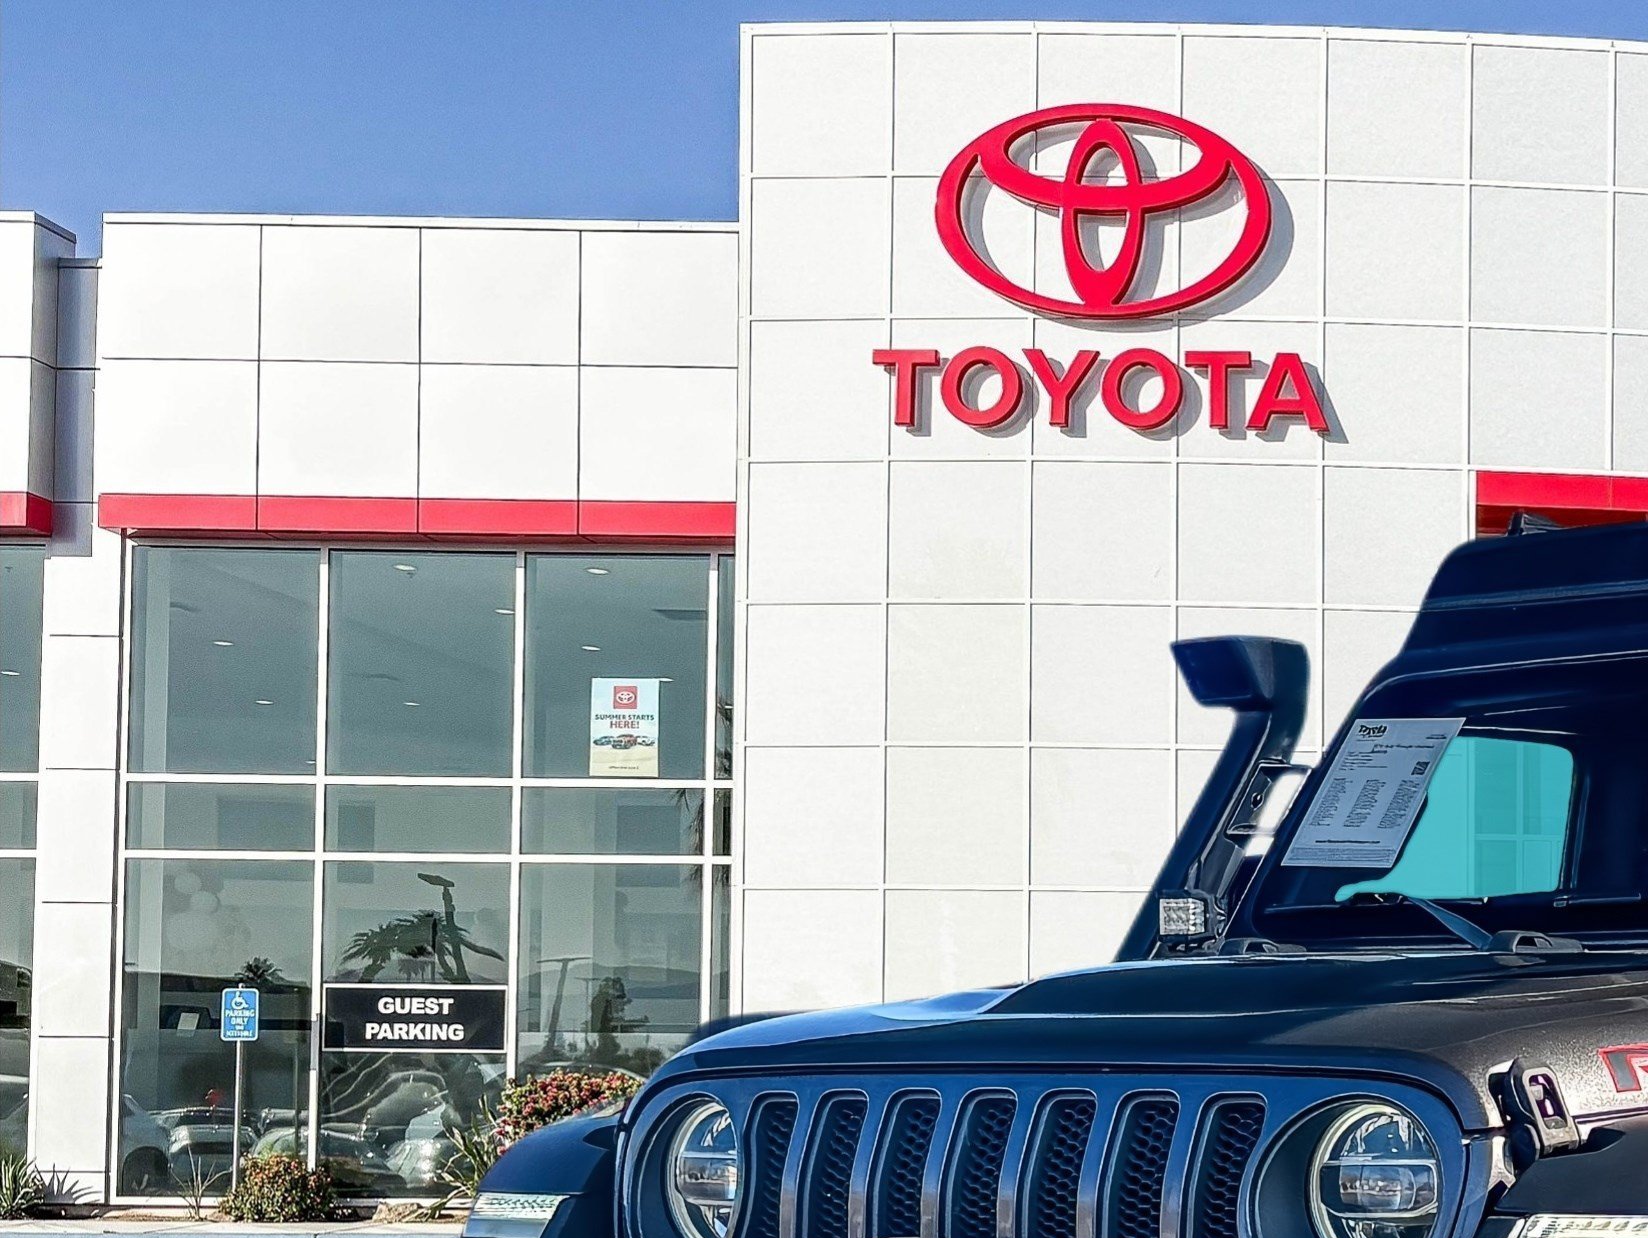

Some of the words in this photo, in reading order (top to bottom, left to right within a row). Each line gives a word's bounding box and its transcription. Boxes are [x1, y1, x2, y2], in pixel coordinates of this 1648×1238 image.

[872, 345, 1330, 433] TOYOTA
[594, 713, 627, 721] SUMMER
[627, 713, 655, 721] STARTS
[609, 720, 640, 729] HERE!
[377, 996, 454, 1015] GUEST
[365, 1022, 465, 1042] PARKING
